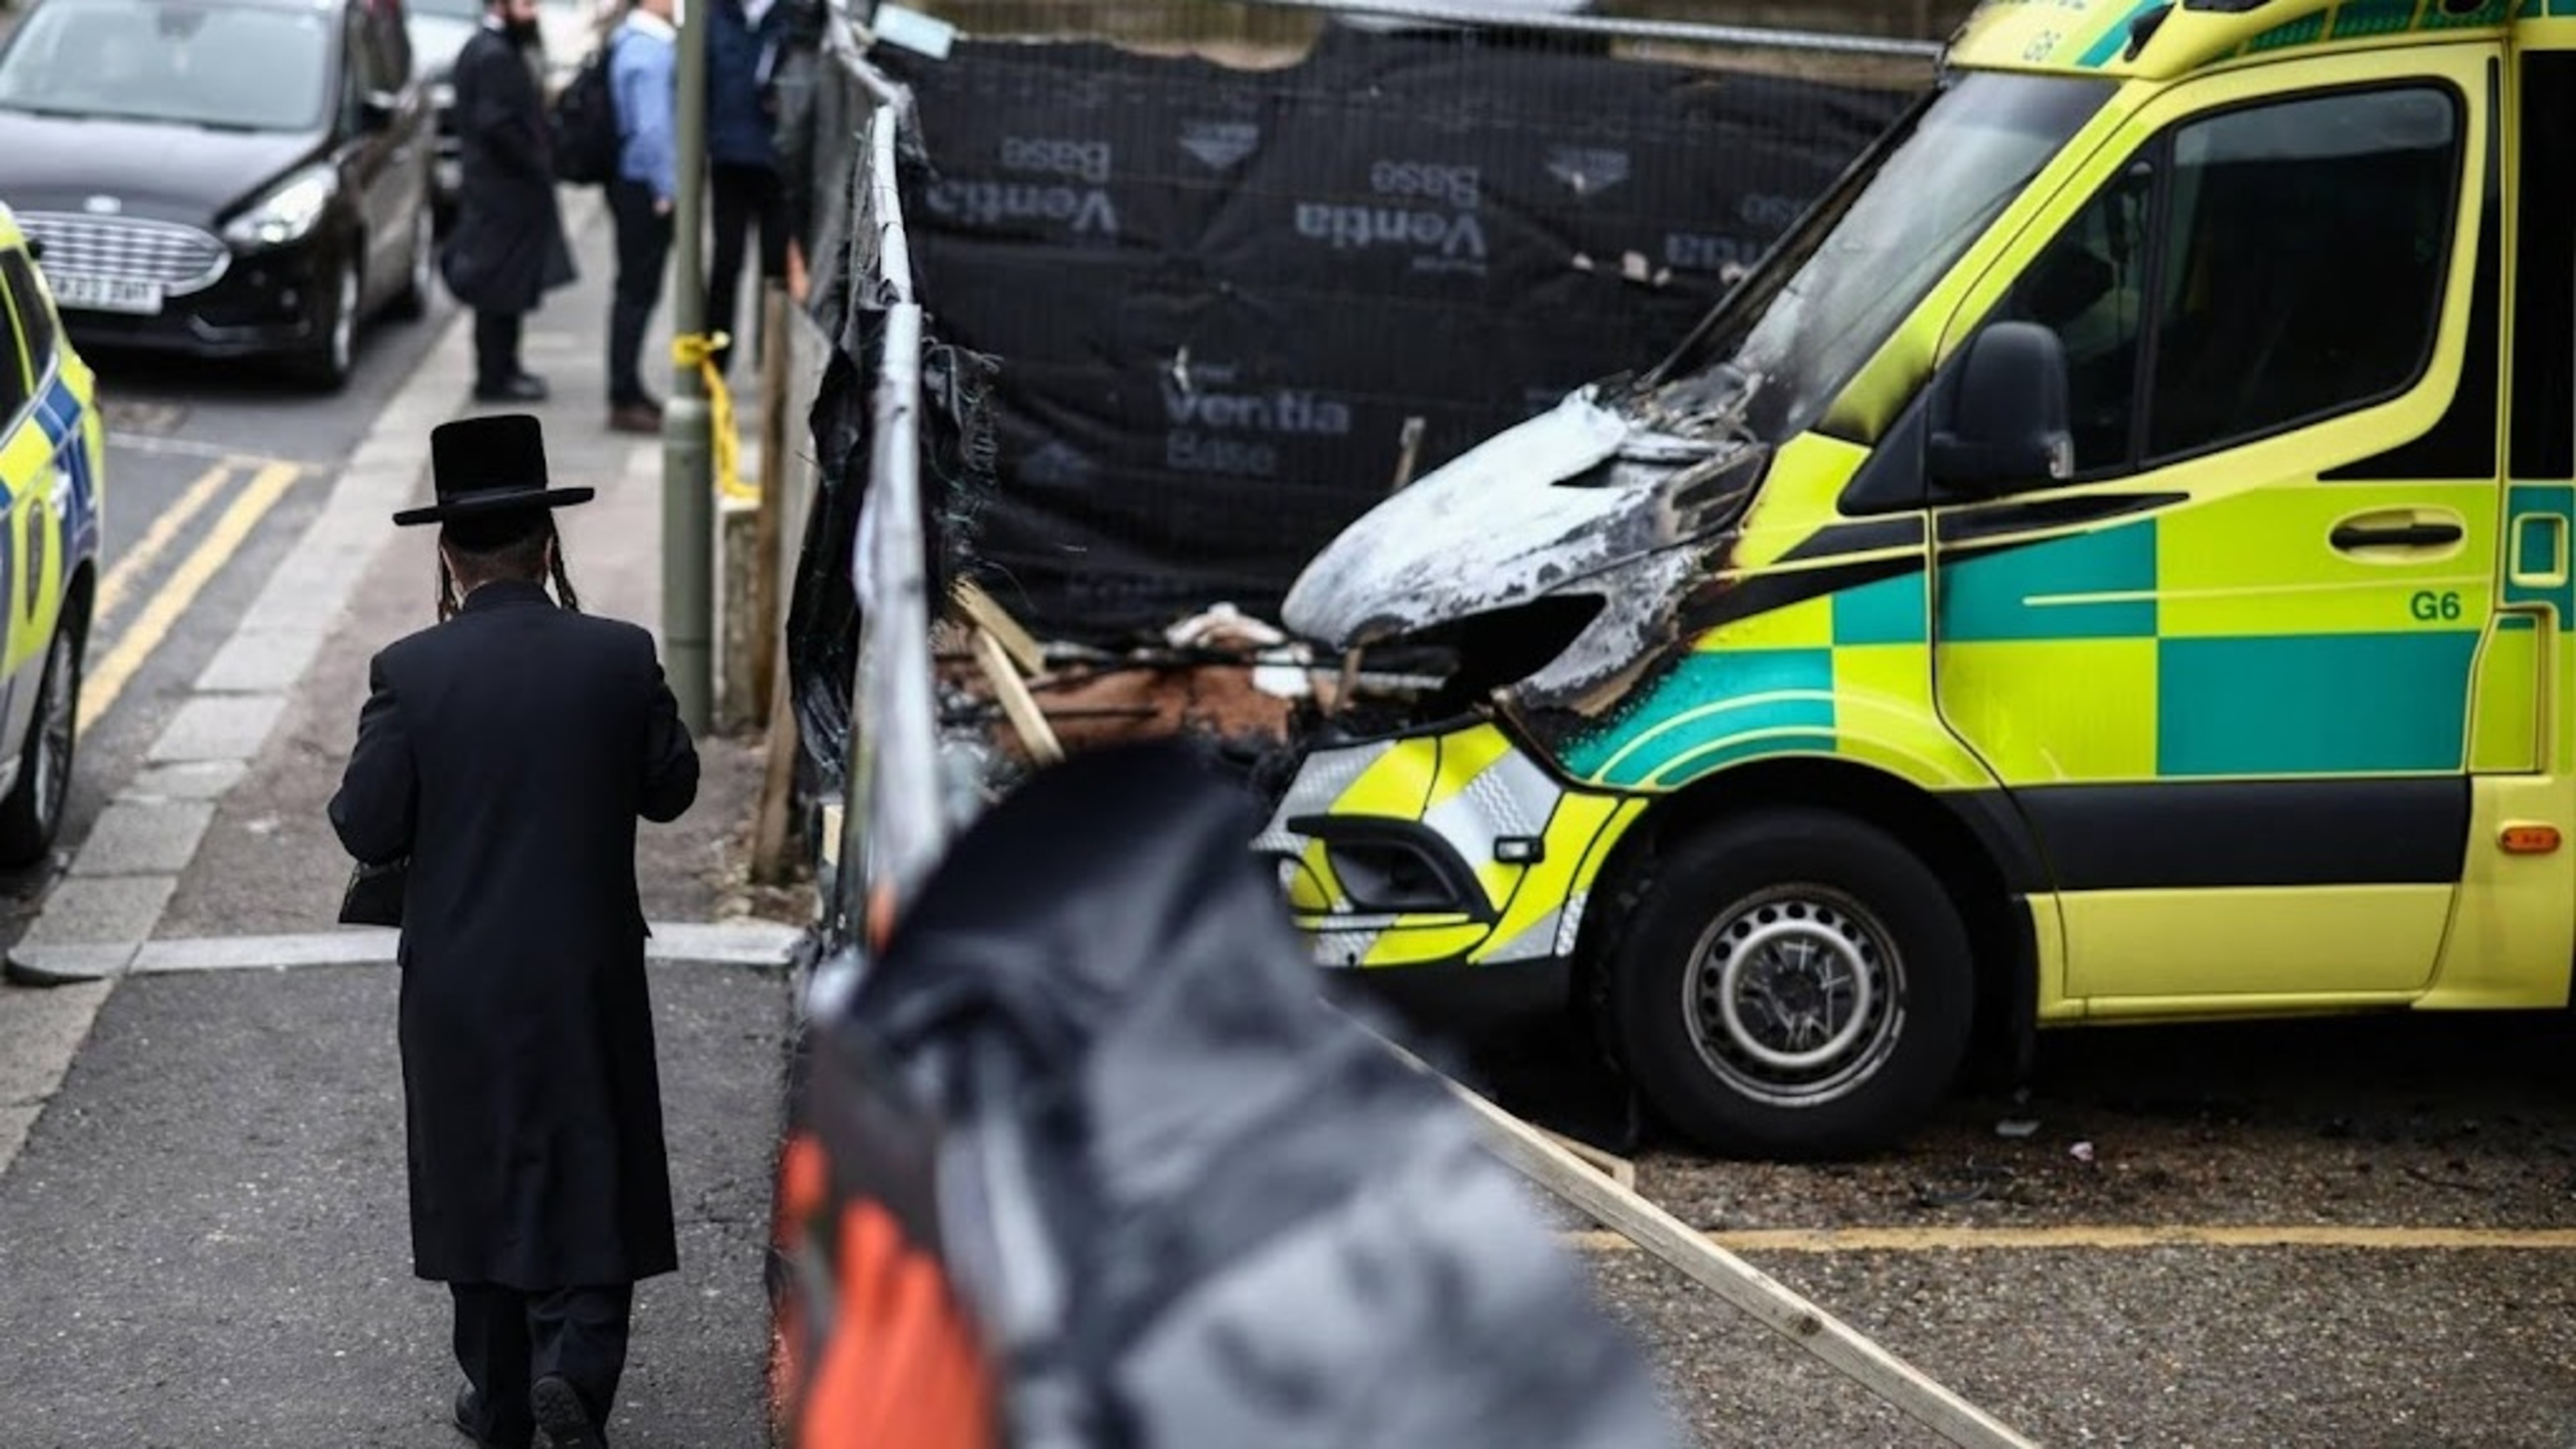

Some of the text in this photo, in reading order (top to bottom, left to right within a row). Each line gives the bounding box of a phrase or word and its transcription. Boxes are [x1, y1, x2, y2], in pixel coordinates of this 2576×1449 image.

[1002, 138, 1111, 182] Base
[1371, 159, 1481, 209] Base
[1295, 201, 1488, 258] Ventia
[1162, 378, 1351, 433] Ventia
[2411, 590, 2461, 621] G6
